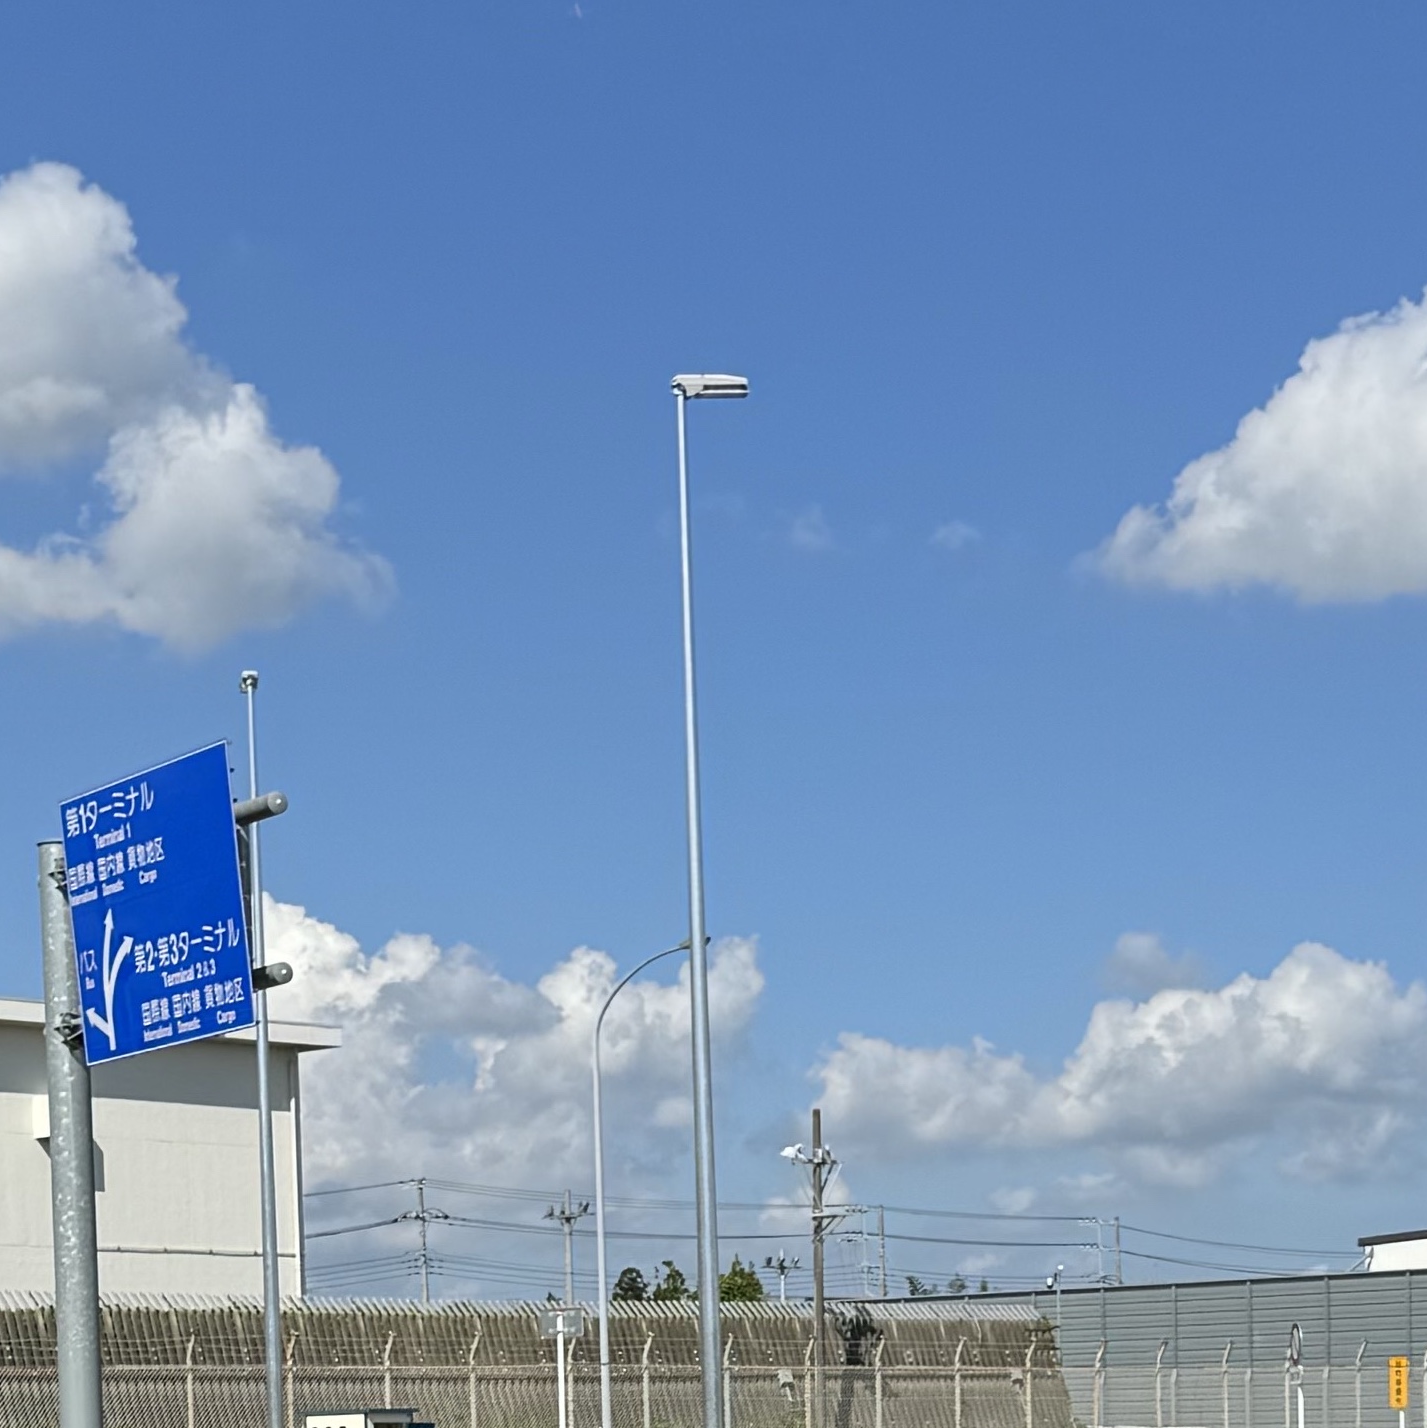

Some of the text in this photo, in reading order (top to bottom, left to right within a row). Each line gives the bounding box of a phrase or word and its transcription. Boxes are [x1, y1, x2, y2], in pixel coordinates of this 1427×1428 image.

[65, 781, 154, 838] 第1ターミナル
[79, 949, 98, 975] バス
